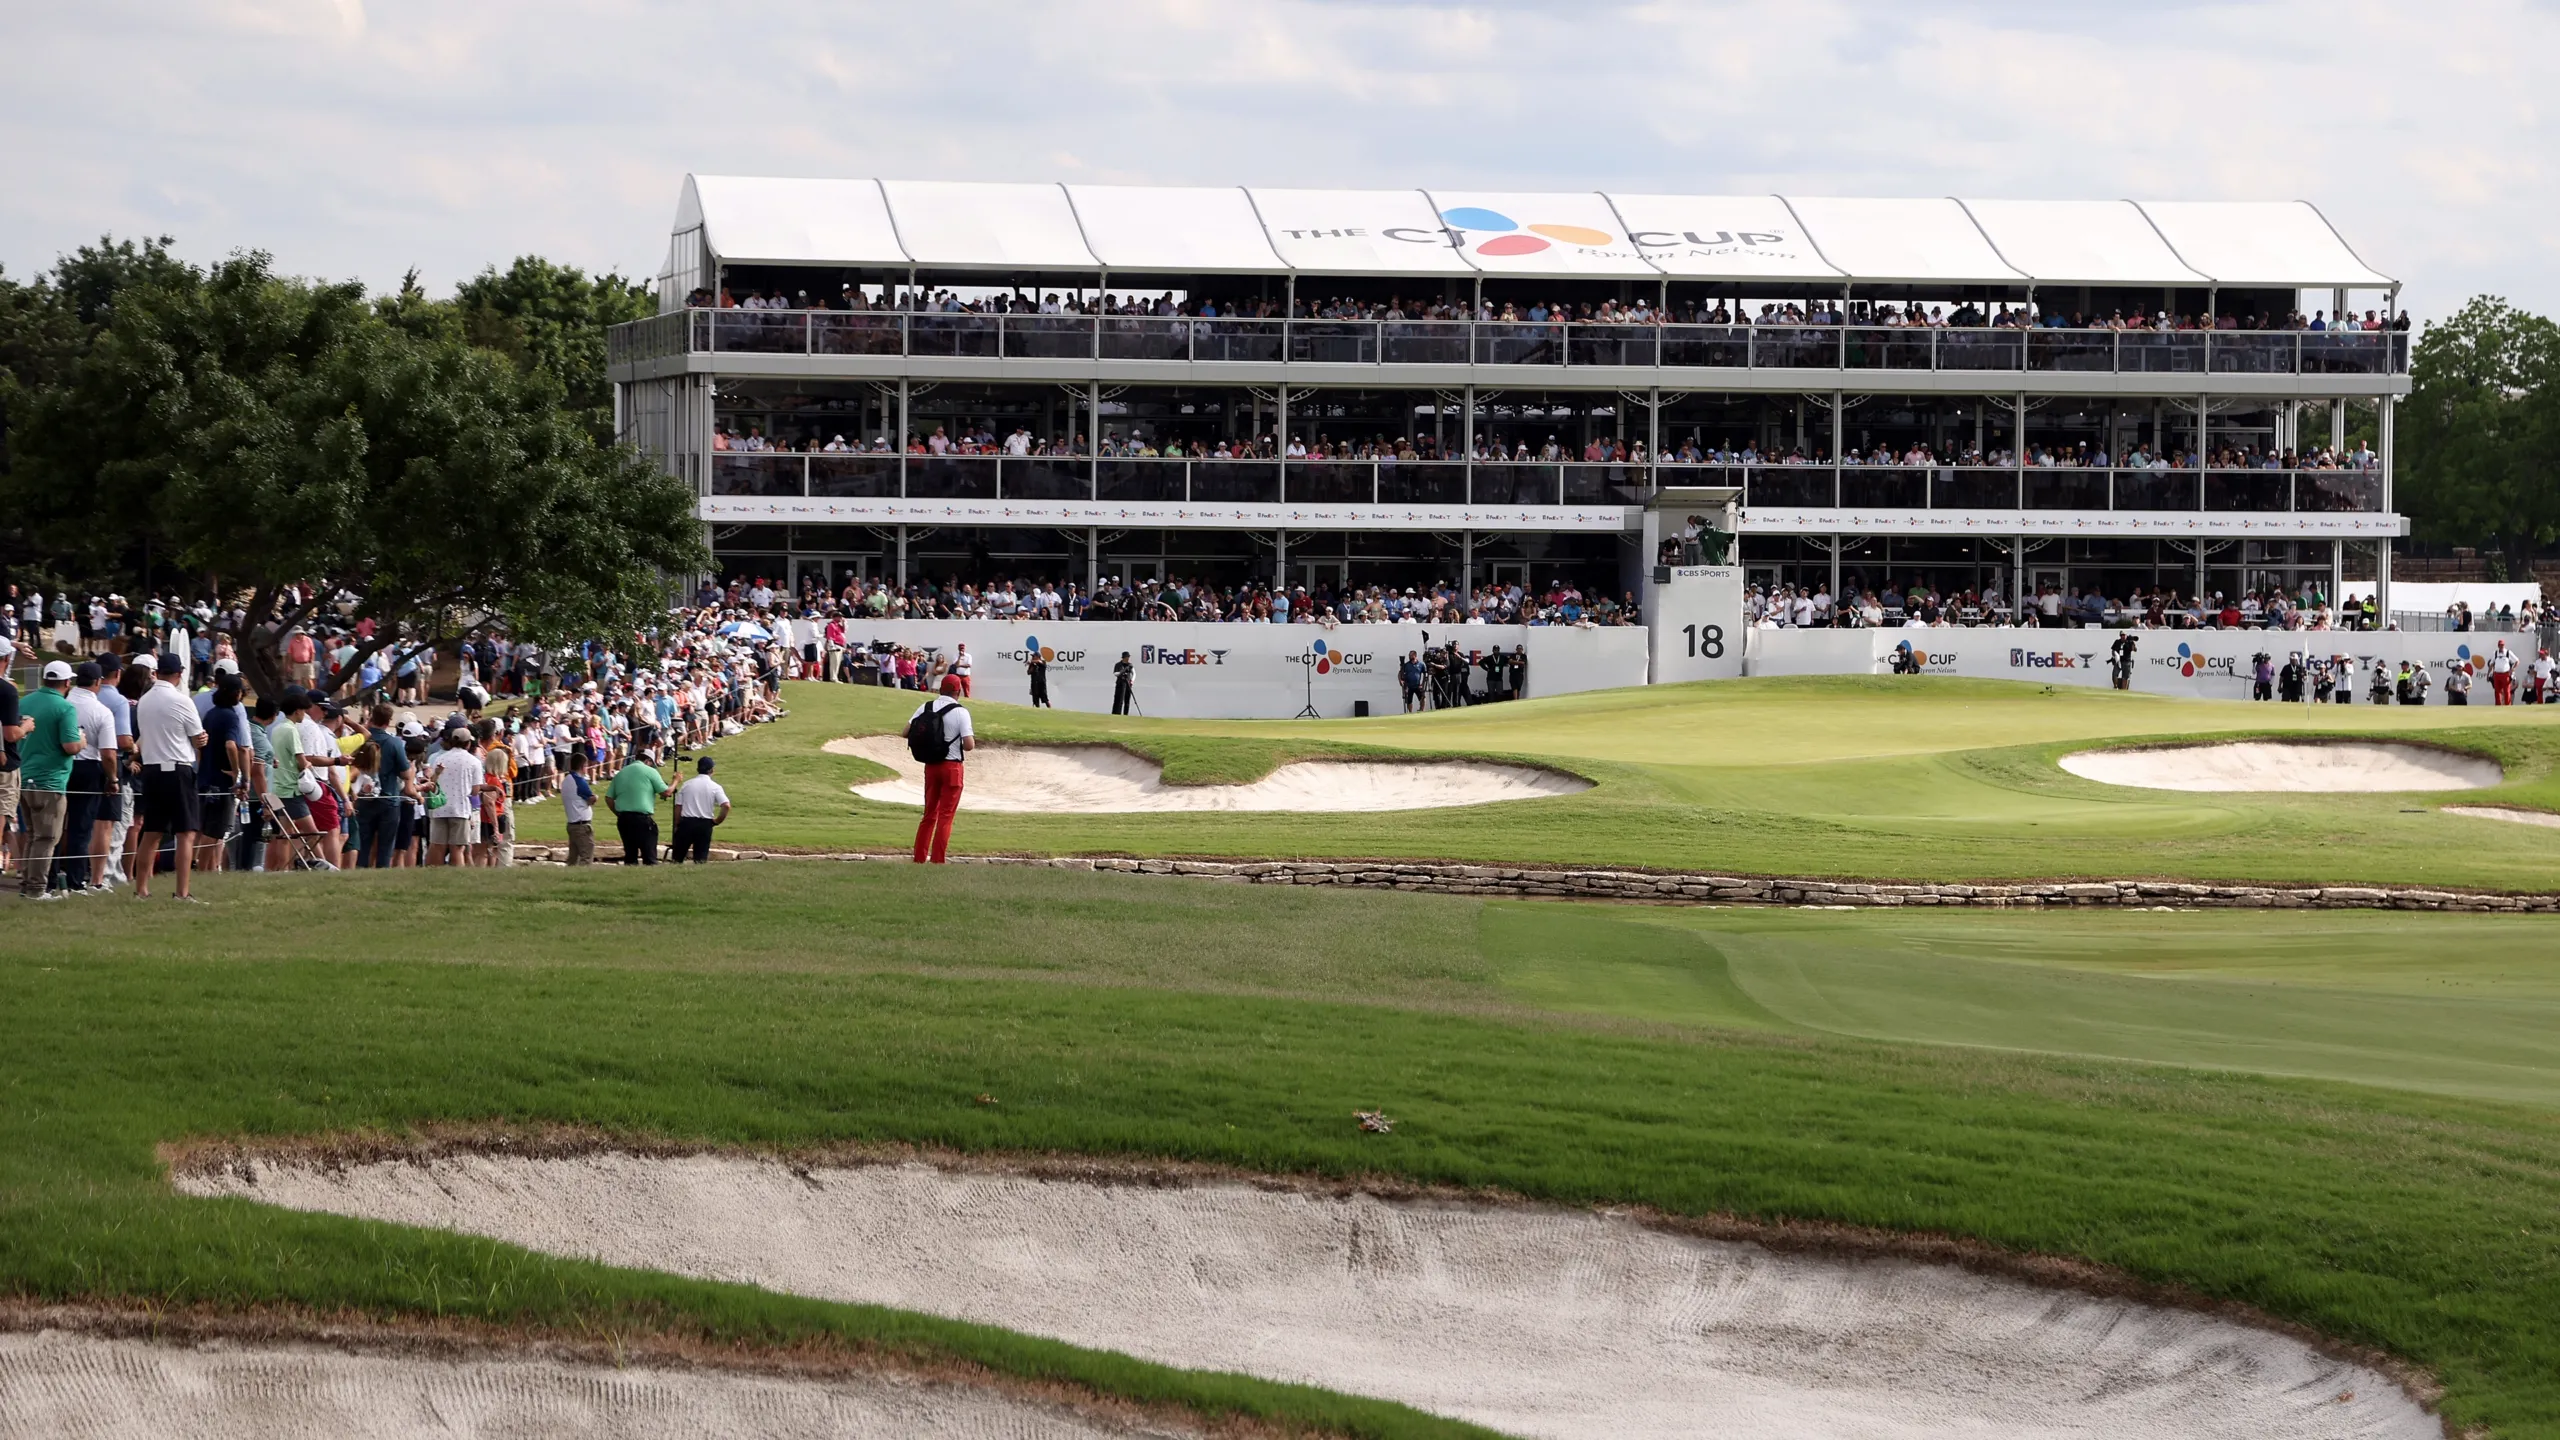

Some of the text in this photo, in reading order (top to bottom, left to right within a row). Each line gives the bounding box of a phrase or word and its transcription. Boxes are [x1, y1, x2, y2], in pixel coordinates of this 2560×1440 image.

[1281, 228, 1784, 248] THE CJ CUP
[1576, 246, 1798, 260] Byron Nelson
[1682, 624, 1724, 658] 18
[1014, 650, 1030, 663] CJ
[1057, 651, 1085, 662] CUP
[1158, 648, 1208, 665] FedEx
[1302, 654, 1317, 667] CJ
[1344, 654, 1372, 664] CUP
[1929, 654, 1956, 665] CUP
[2027, 652, 2075, 668] FedEx
[2166, 656, 2182, 670] CJ
[2208, 658, 2235, 668] CUP
